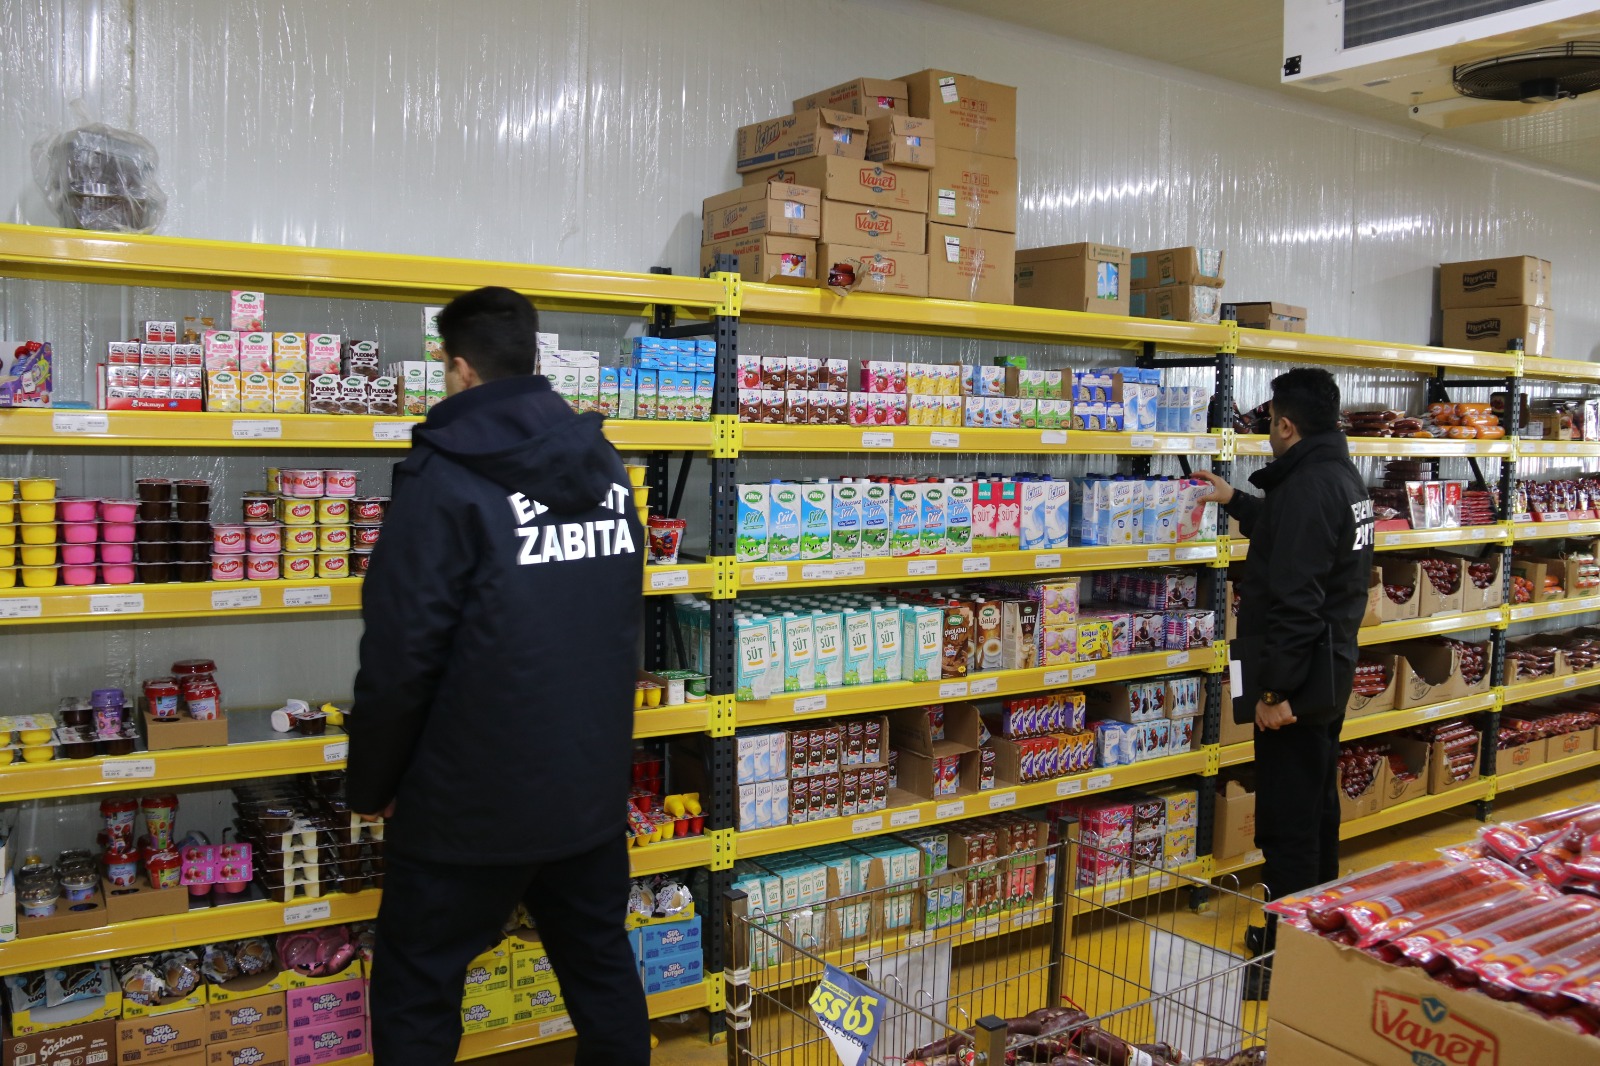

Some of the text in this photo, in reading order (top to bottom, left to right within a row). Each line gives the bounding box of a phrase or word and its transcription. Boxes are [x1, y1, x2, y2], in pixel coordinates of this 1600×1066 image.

[862, 171, 894, 188] Vanet
[858, 215, 889, 231] Vanet
[977, 509, 990, 522] SÜT
[1001, 509, 1014, 522] SÜT
[514, 519, 635, 566] ZABITA
[1021, 615, 1035, 625] LATTE
[821, 635, 836, 648] SÜT
[853, 633, 867, 647] SÜT
[881, 631, 895, 644] SÜT
[922, 631, 935, 645] SÜT
[793, 638, 808, 651] SÜT
[747, 646, 763, 661] SÜT
[662, 935, 684, 945] Burger
[663, 967, 686, 979] Burger
[669, 963, 681, 971] Süt
[320, 994, 335, 1004] Süt
[531, 995, 555, 1006] Burger
[537, 990, 550, 999] Süt
[314, 999, 341, 1011] Burger
[471, 1004, 485, 1014] Süt
[232, 1013, 261, 1025] Burger
[239, 1007, 256, 1018] Süt
[464, 1010, 490, 1021] Burger
[153, 1025, 172, 1036] Süt
[321, 1031, 336, 1041] Süt
[1377, 1000, 1490, 1066] Vanet
[145, 1030, 178, 1045] Burger
[315, 1036, 342, 1049] Burger
[841, 1030, 869, 1052] SUCUK
[40, 1034, 83, 1062] Sosbom
[241, 1047, 257, 1058] Süt
[234, 1052, 264, 1065] Burger
